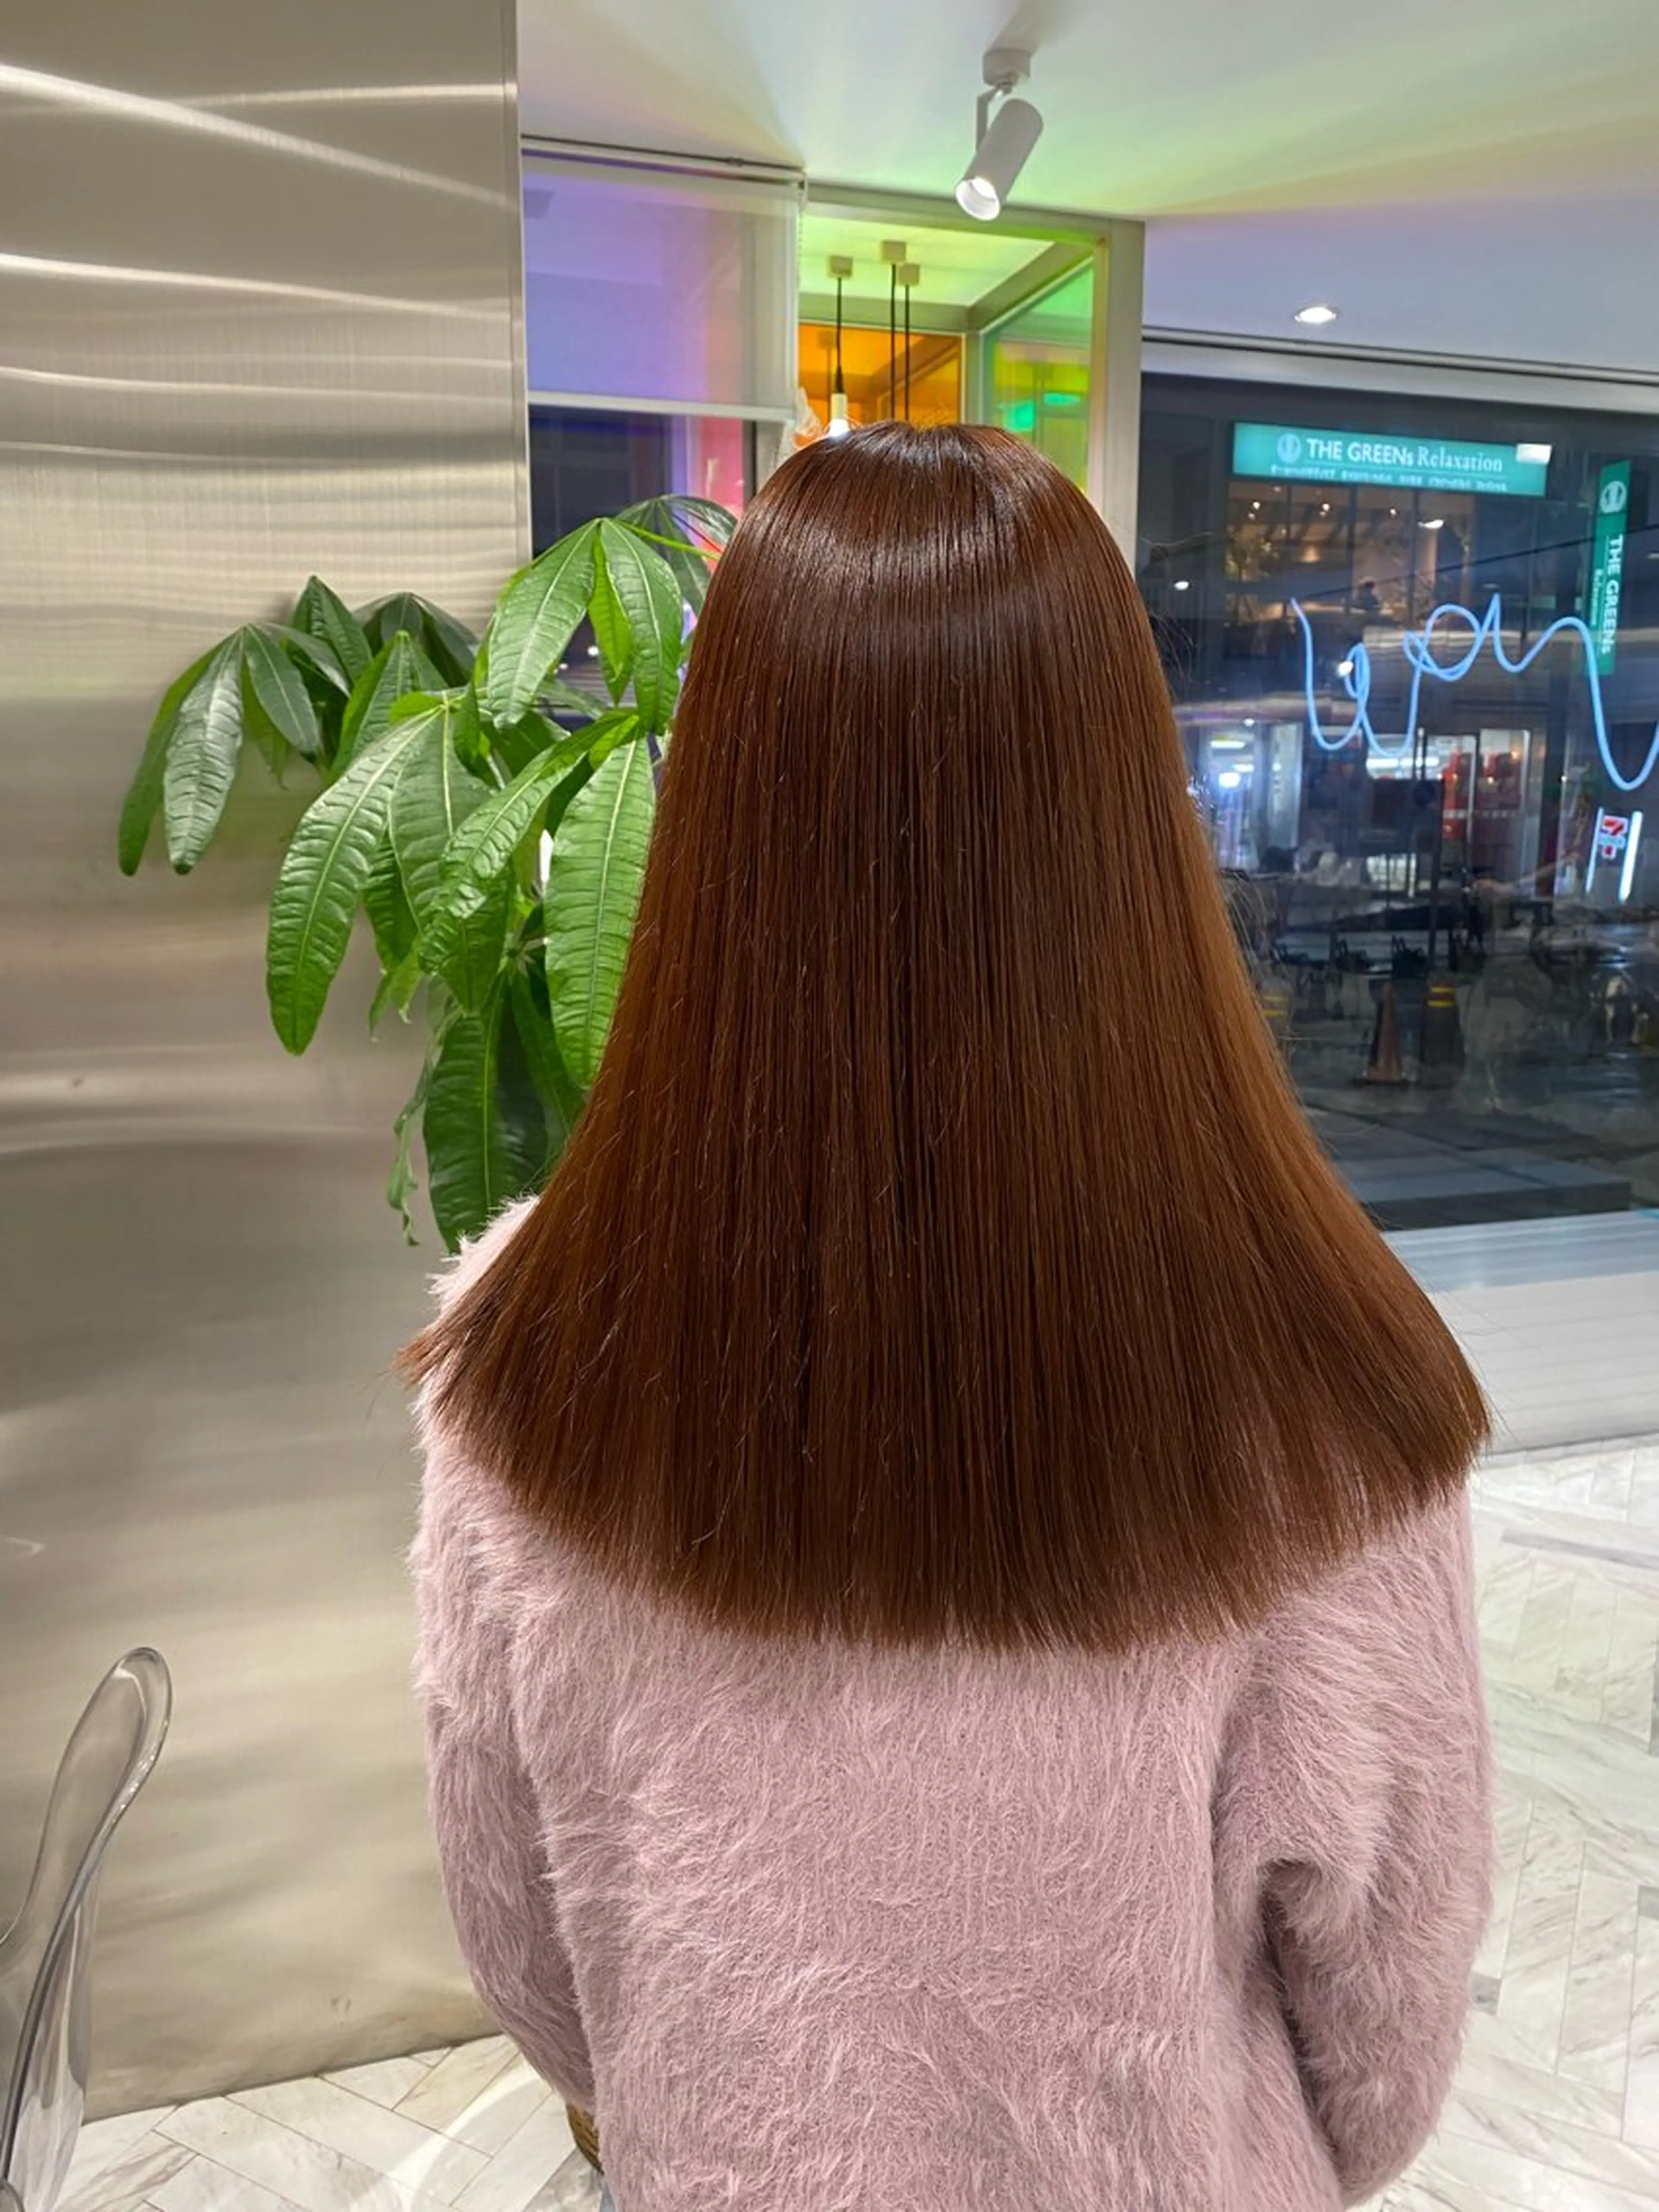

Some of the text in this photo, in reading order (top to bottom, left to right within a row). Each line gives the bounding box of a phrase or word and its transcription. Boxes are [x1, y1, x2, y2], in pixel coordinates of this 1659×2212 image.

[1306, 437, 1503, 473] THE GREENs Relaxation
[1608, 534, 1623, 576] THE
